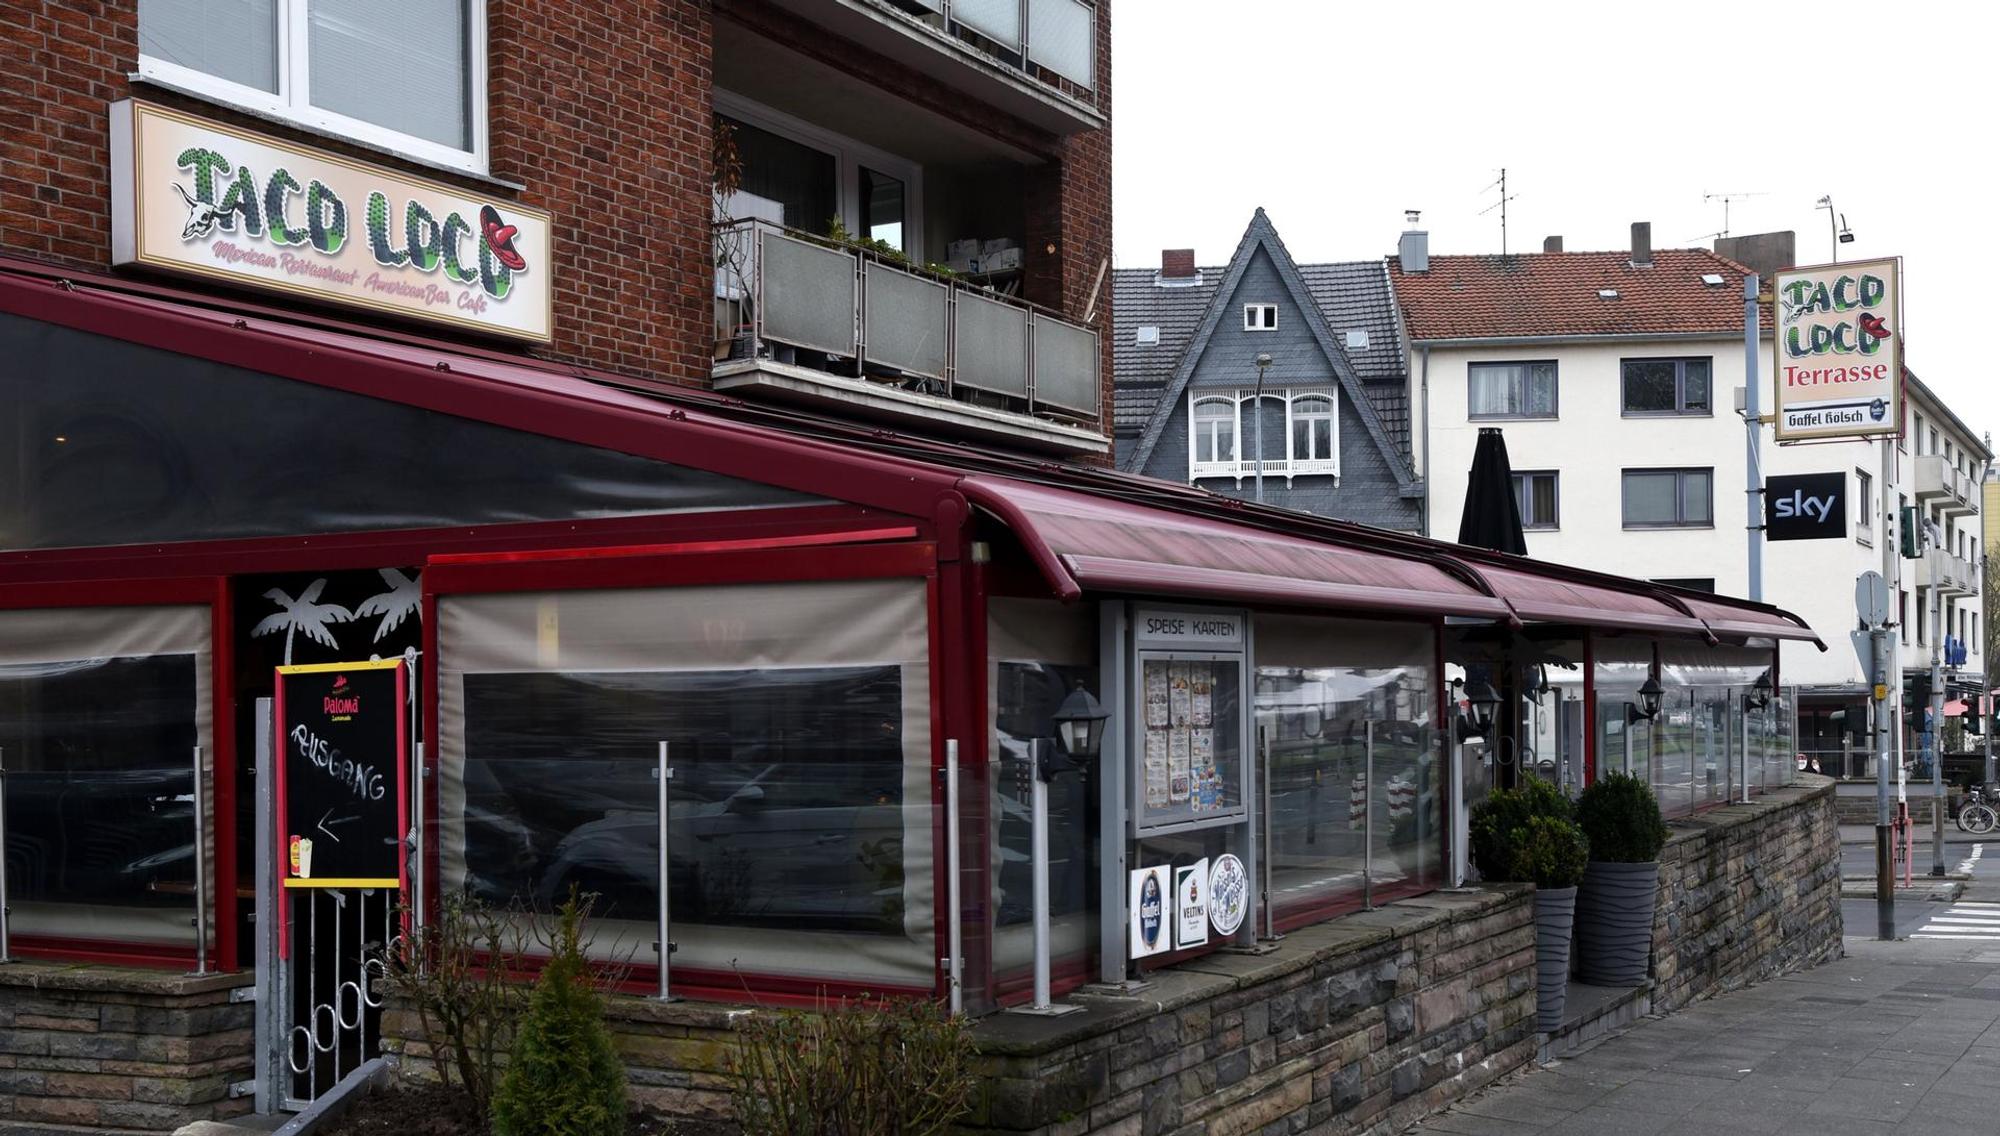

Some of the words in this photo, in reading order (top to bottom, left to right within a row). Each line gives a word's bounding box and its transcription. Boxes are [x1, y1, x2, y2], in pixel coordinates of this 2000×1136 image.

[177, 147, 348, 255] TACO
[365, 191, 516, 299] LOCO
[212, 240, 277, 268] Mexican
[280, 252, 359, 286] Restaurant
[1783, 273, 1886, 313] TACO
[1785, 320, 1882, 358] LOCO
[1783, 364, 1888, 387] Terrasse
[1788, 412, 1822, 427] Gaffel
[1825, 410, 1863, 424] Kölsch
[1775, 489, 1836, 523] sky
[1147, 618, 1185, 634] SPEISE
[1192, 621, 1235, 636] KARTEN
[1184, 905, 1204, 919] VELTINS
